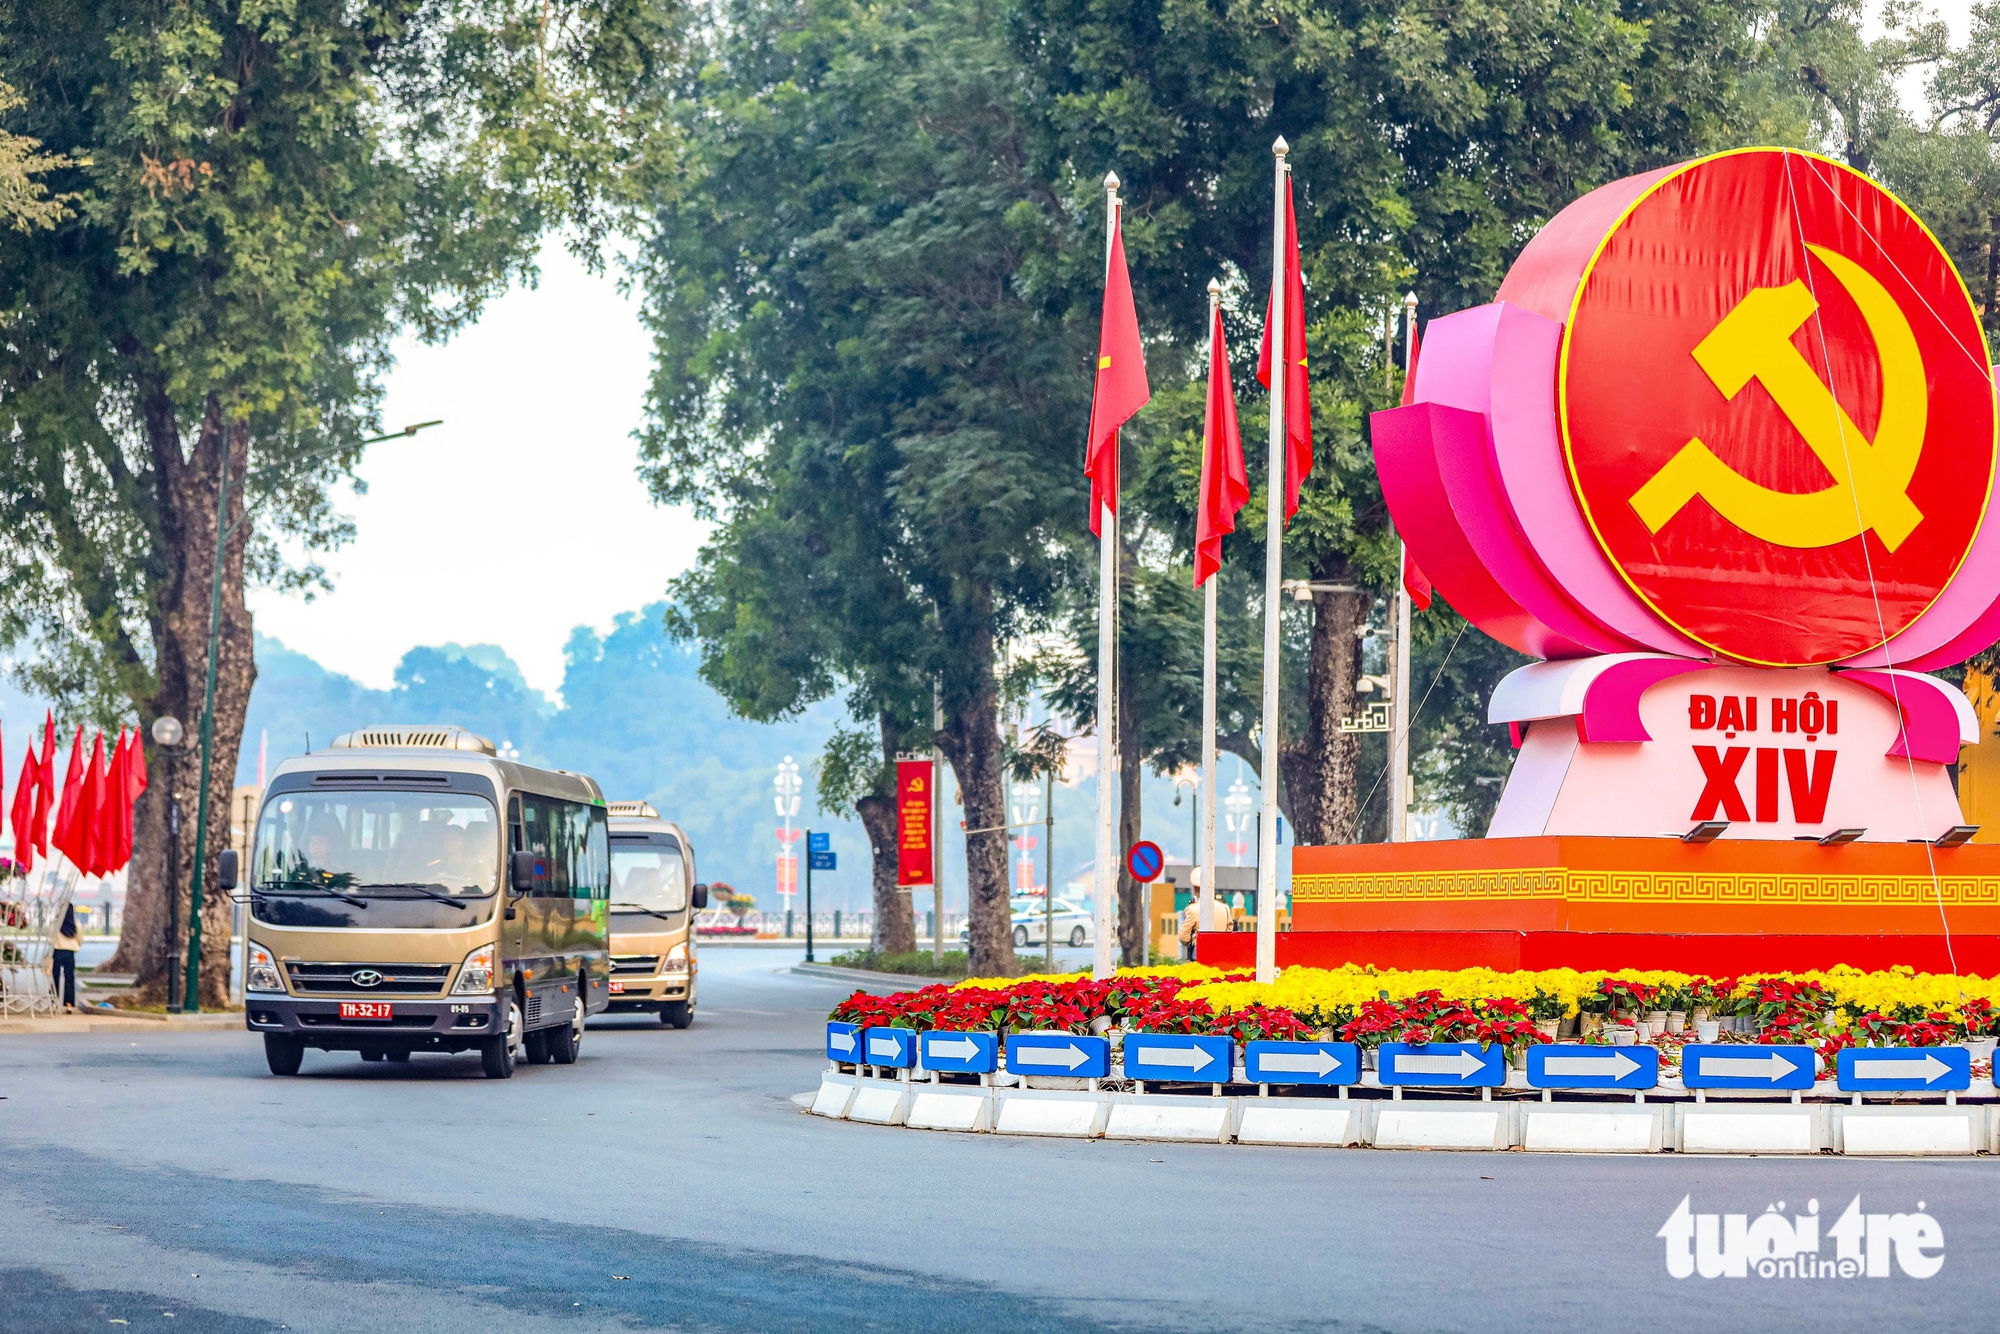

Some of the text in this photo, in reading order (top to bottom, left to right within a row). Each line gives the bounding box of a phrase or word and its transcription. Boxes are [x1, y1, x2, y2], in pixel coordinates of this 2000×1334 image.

[1689, 692, 1838, 741] ĐẠI HỘI
[1690, 745, 1838, 823] XIV
[341, 1003, 391, 1017] TH-32-17
